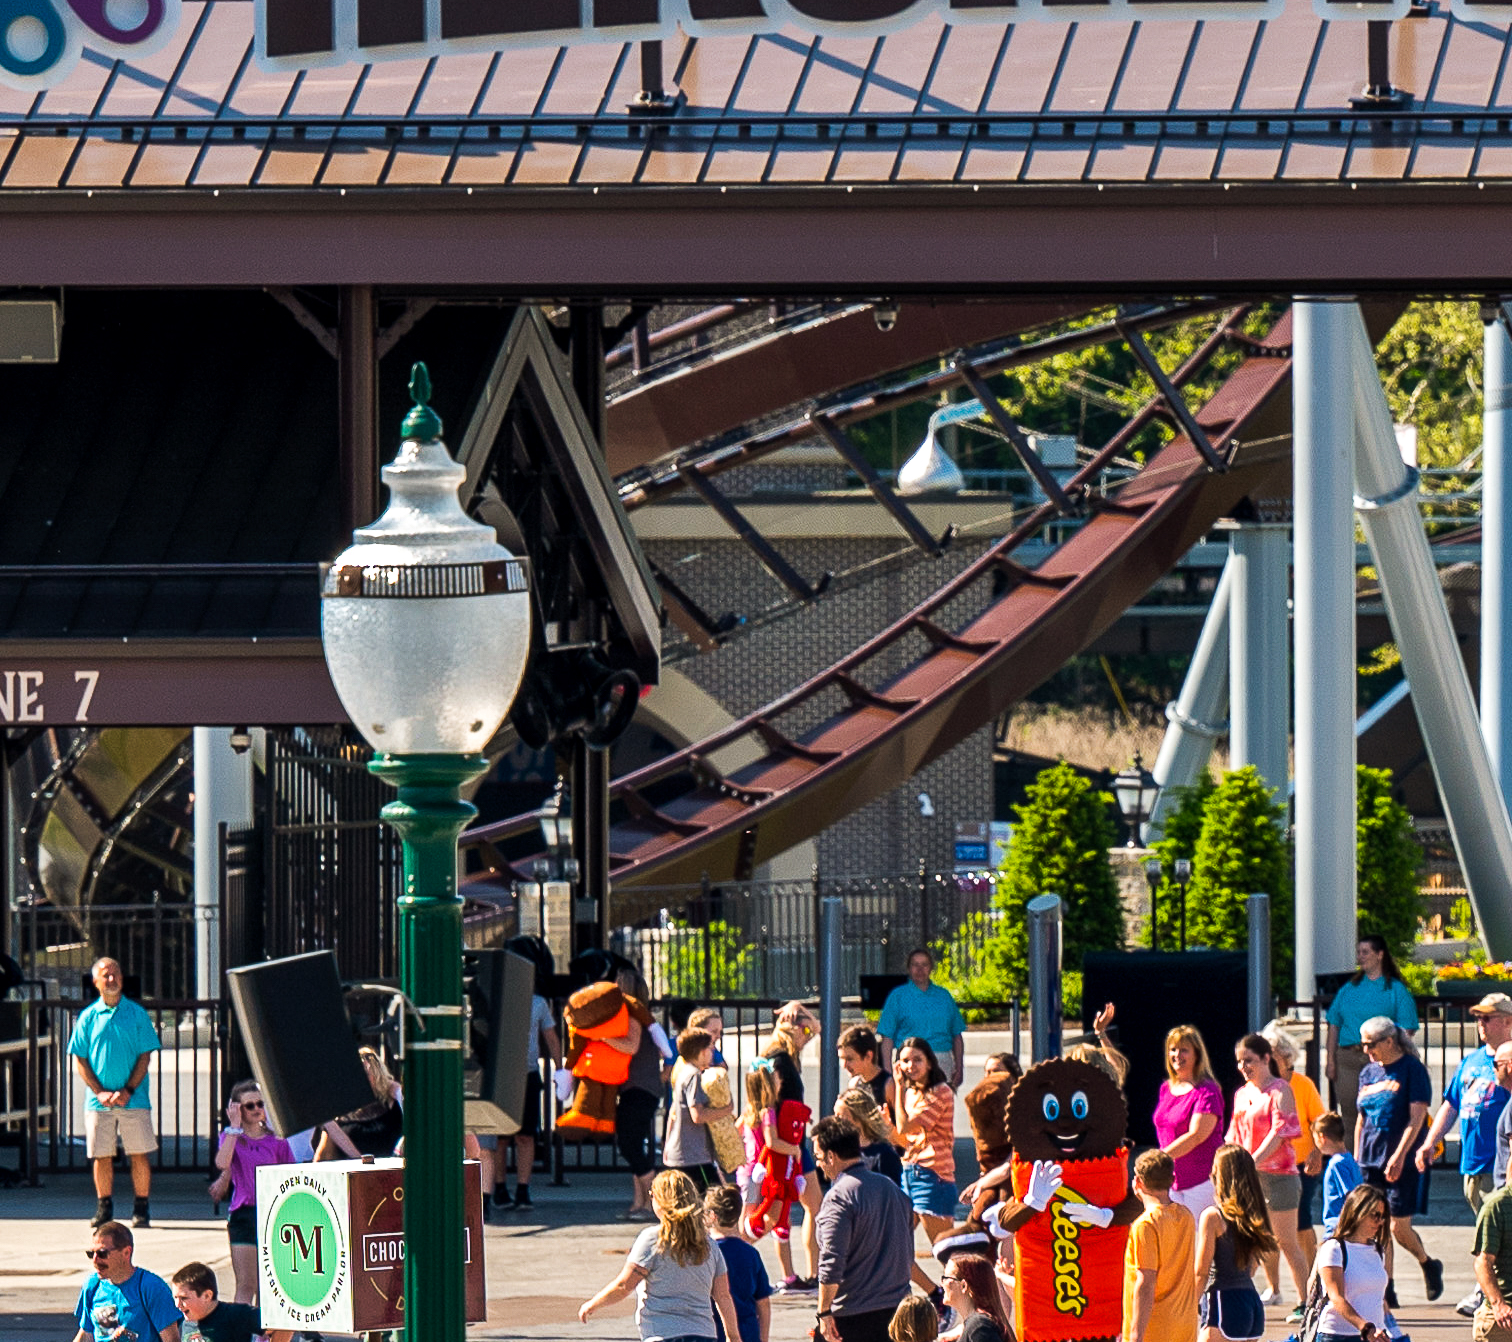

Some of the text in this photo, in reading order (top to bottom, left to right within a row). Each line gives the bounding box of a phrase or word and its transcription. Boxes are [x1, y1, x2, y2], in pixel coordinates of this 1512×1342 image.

[74, 670, 100, 721] 7
[279, 1175, 327, 1197] OPEN DAILY
[280, 1223, 325, 1275] M
[262, 1246, 286, 1308] MILTON'S
[287, 1305, 301, 1322] ICE
[305, 1302, 332, 1323] CREAM
[331, 1250, 346, 1303] PARLOR
